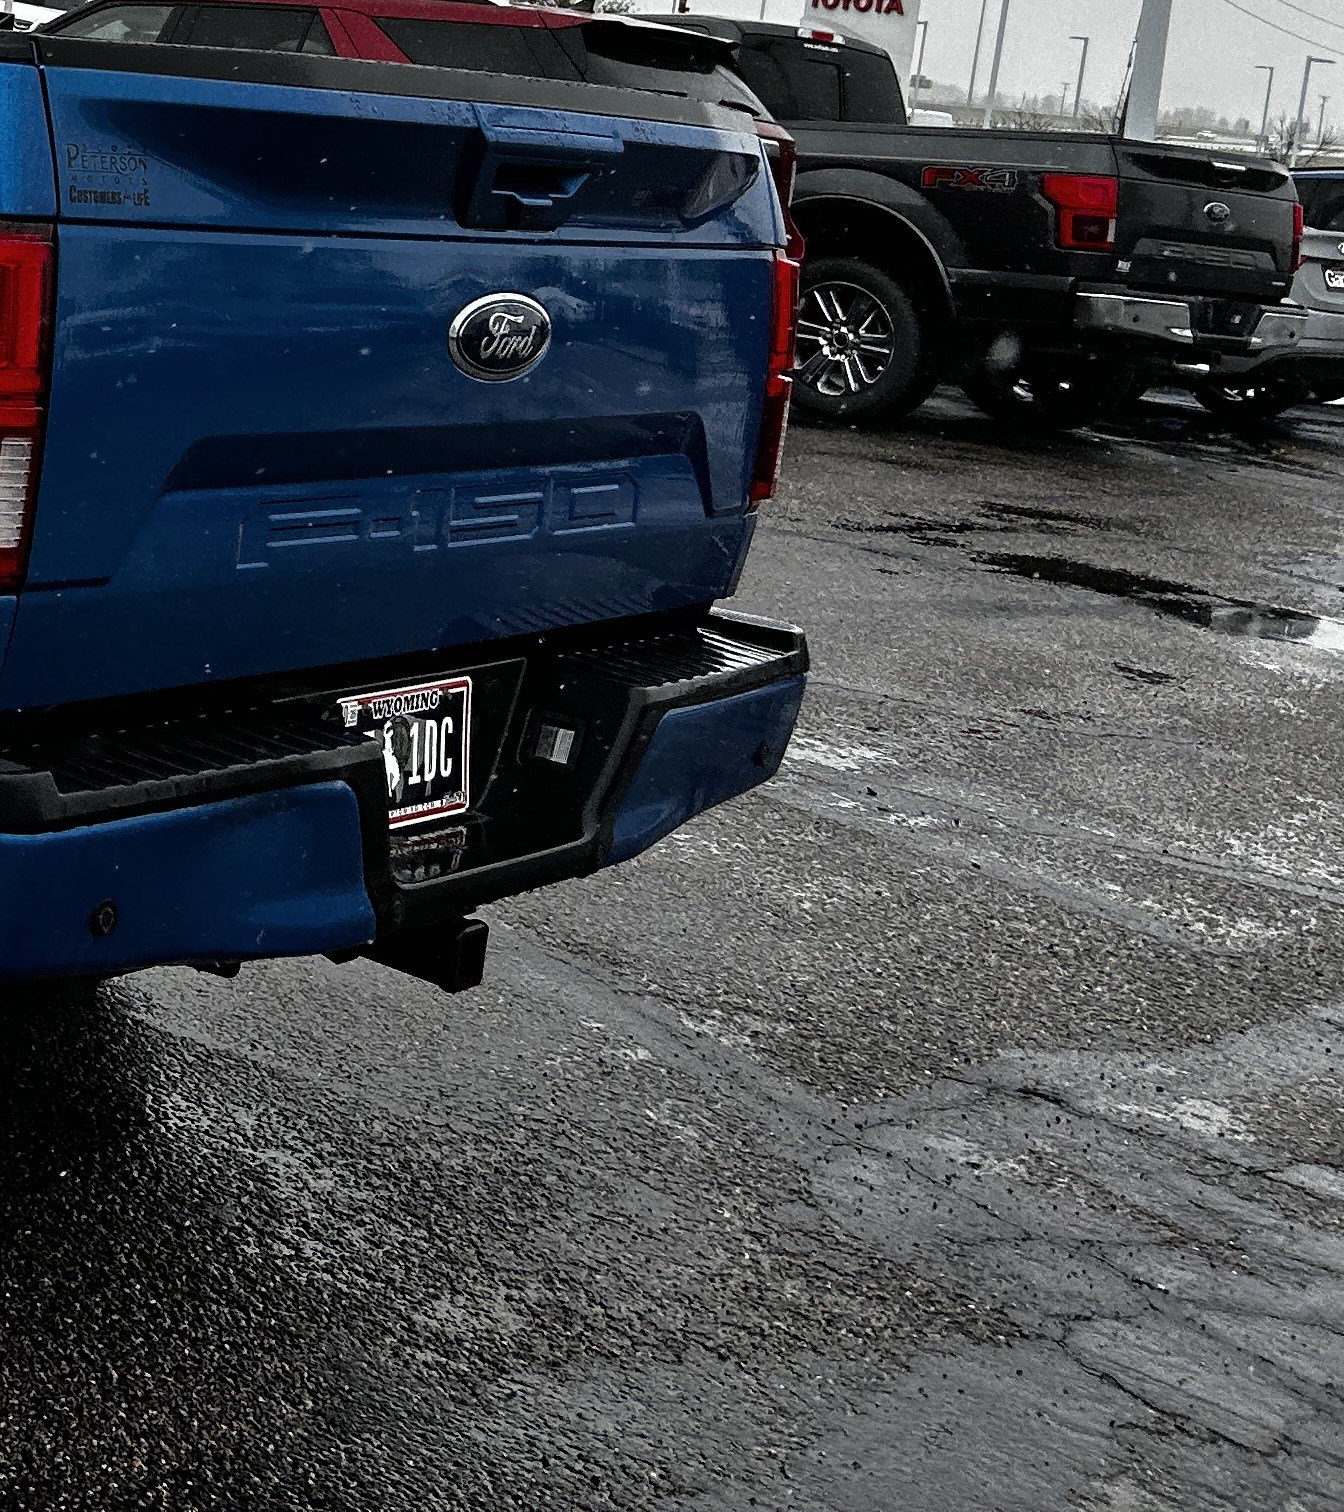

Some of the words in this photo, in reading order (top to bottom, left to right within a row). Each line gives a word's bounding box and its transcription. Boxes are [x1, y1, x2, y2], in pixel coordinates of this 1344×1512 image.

[66, 143, 149, 174] PETERSON
[920, 166, 1018, 189] FX4
[479, 312, 537, 360] Ford
[371, 689, 440, 719] WYOMING
